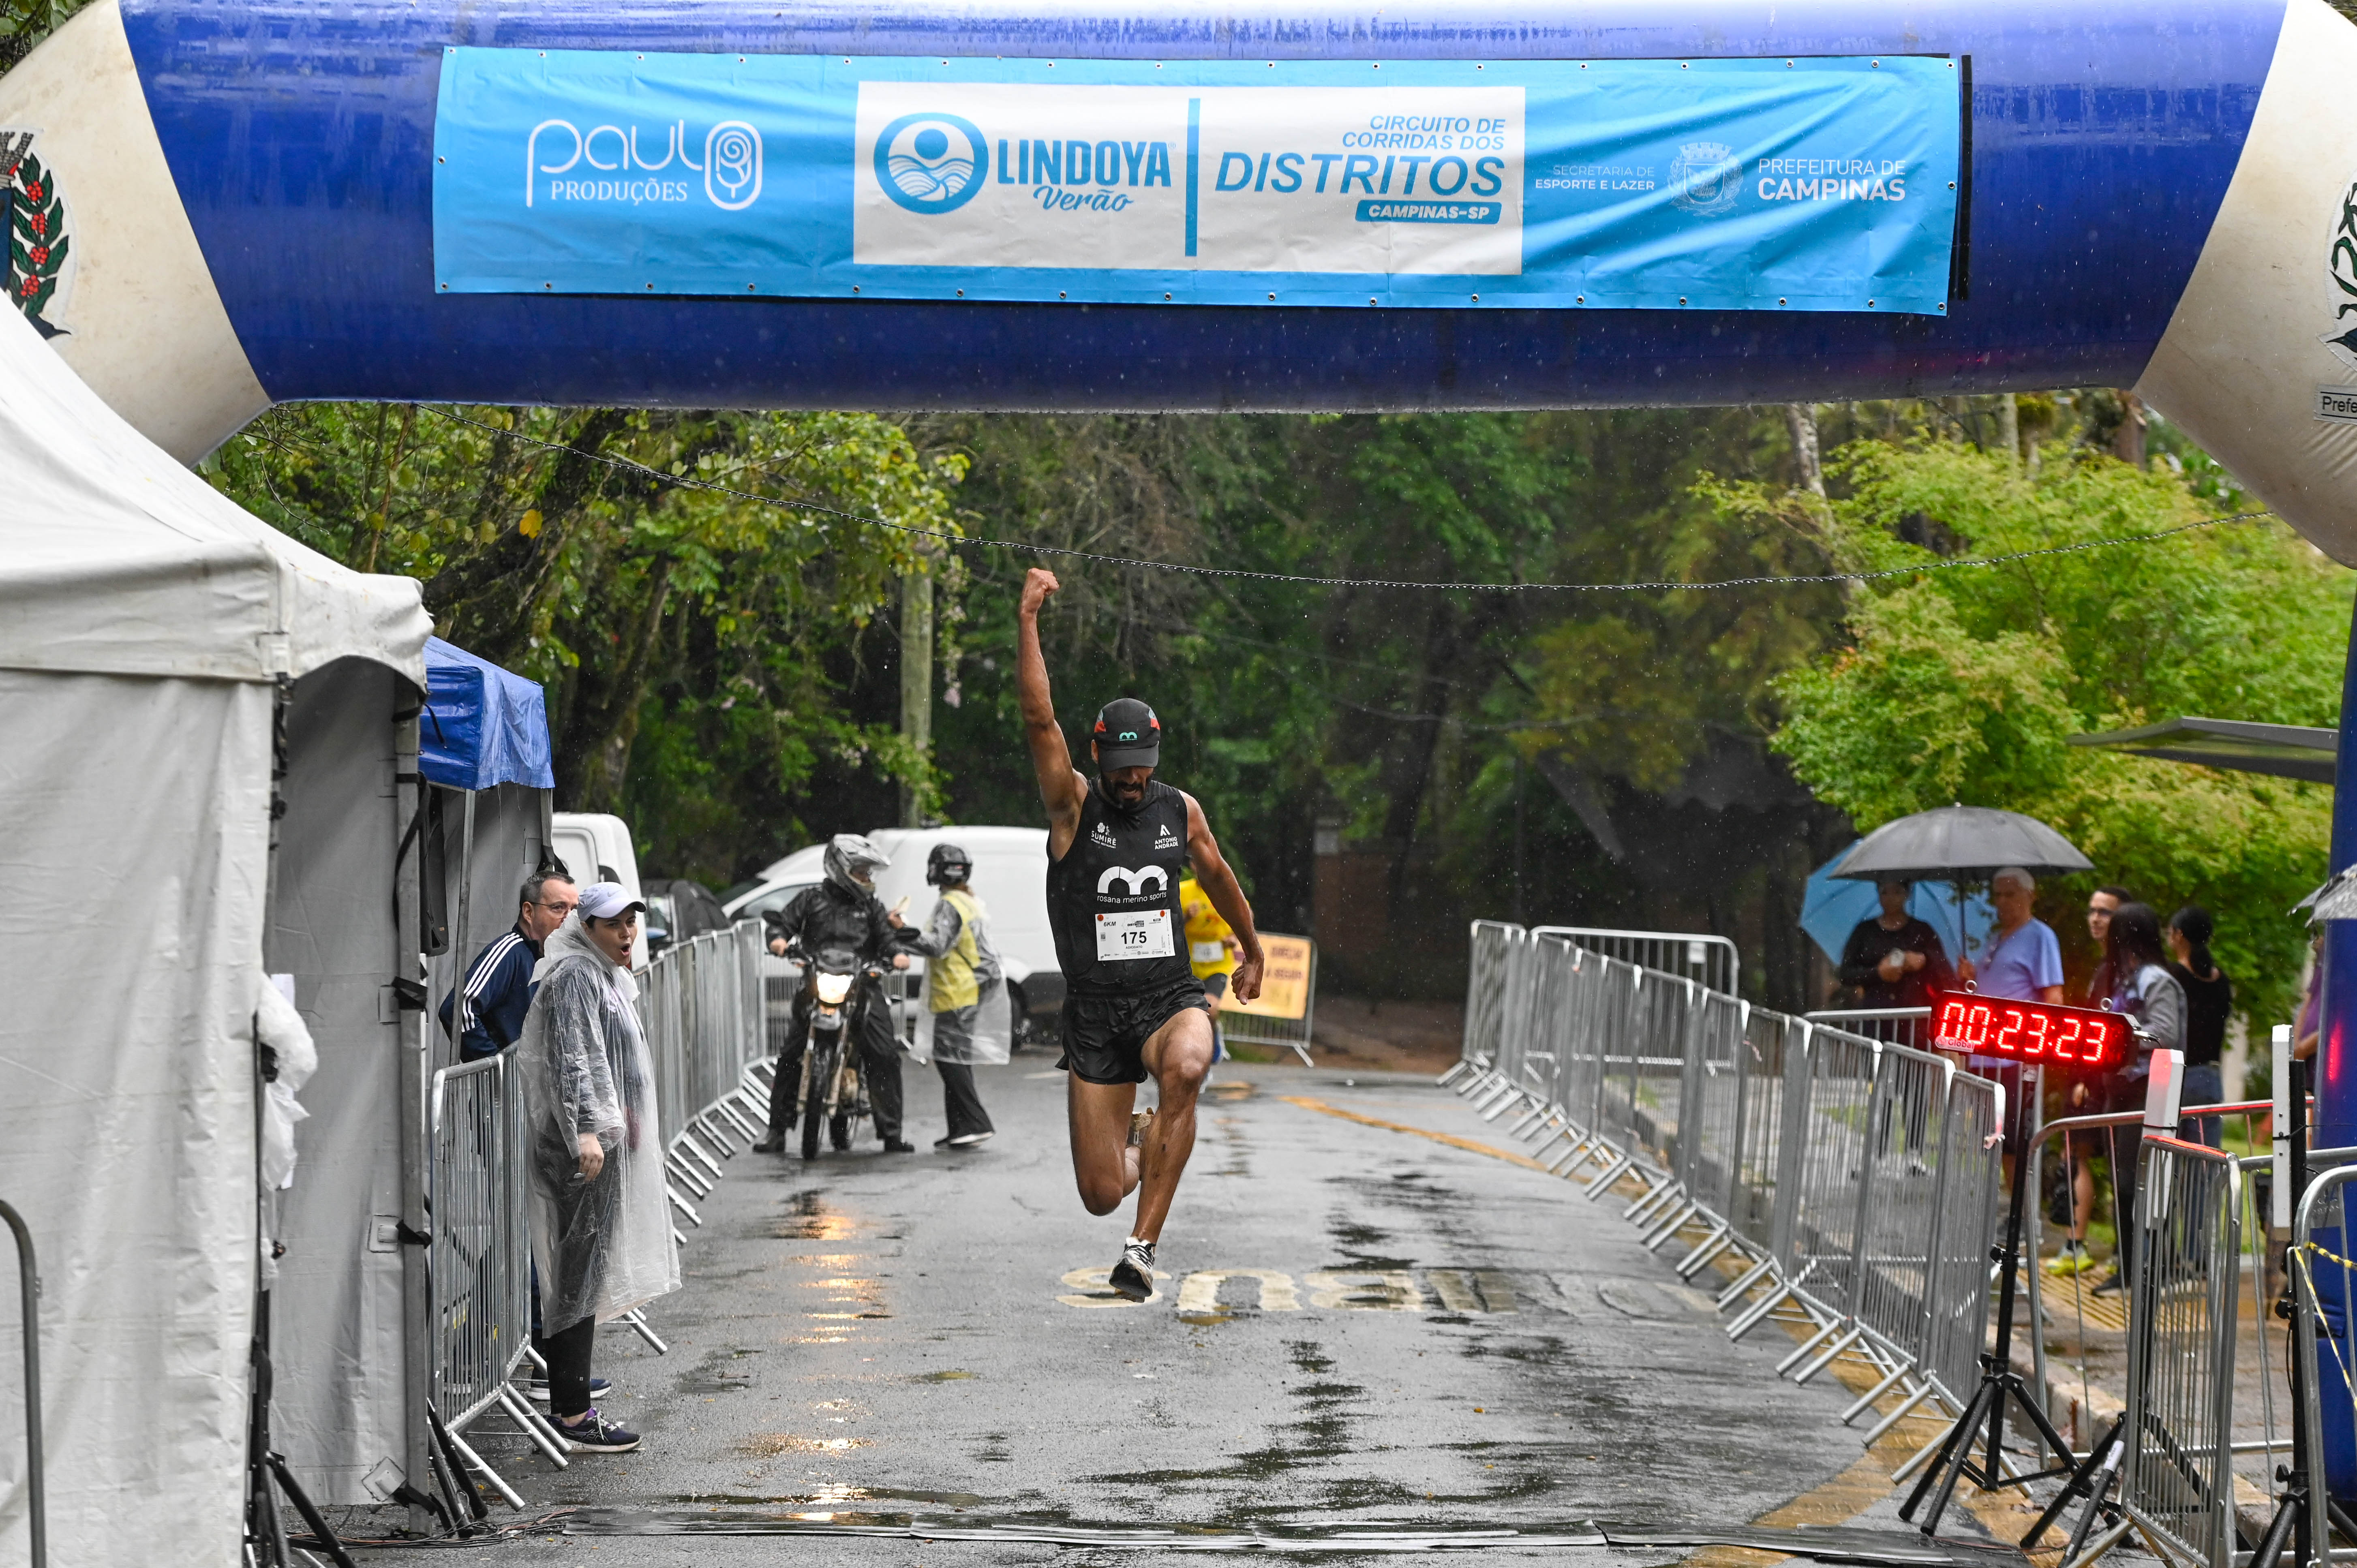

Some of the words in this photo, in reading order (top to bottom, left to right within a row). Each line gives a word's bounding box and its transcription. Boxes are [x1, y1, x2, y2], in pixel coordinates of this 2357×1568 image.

[1370, 116, 1470, 133] CIRCUITO
[1477, 118, 1506, 134] DE
[1342, 132, 1453, 149] CORRIDAS
[1460, 136, 1504, 150] DOS
[1215, 151, 1505, 197] DISTRITOS
[1553, 165, 1634, 177] SECRETARIA
[1638, 166, 1655, 177] DE
[1758, 158, 1876, 175] PREFEITURA
[1881, 160, 1906, 175] DE
[550, 177, 688, 205] PRODUÇÕES
[1535, 178, 1597, 190] ESPORTE
[1600, 179, 1608, 190] E
[1612, 180, 1655, 190] LAZER
[1758, 177, 1906, 201] CAMPINAS
[1033, 185, 1134, 212] Verão
[1368, 204, 1490, 220] CAMPINAS-SP
[1091, 830, 1117, 846] SUMIRÊ
[1154, 836, 1177, 845] ANTONIO
[1154, 841, 1179, 849] ANDRADE
[1097, 895, 1120, 903] rosana
[1123, 895, 1147, 903] merino
[1150, 892, 1167, 901] sports
[1121, 931, 1147, 945] 175
[1940, 1002, 2107, 1061] 00:23:23
[1948, 1039, 1974, 1049] Global
